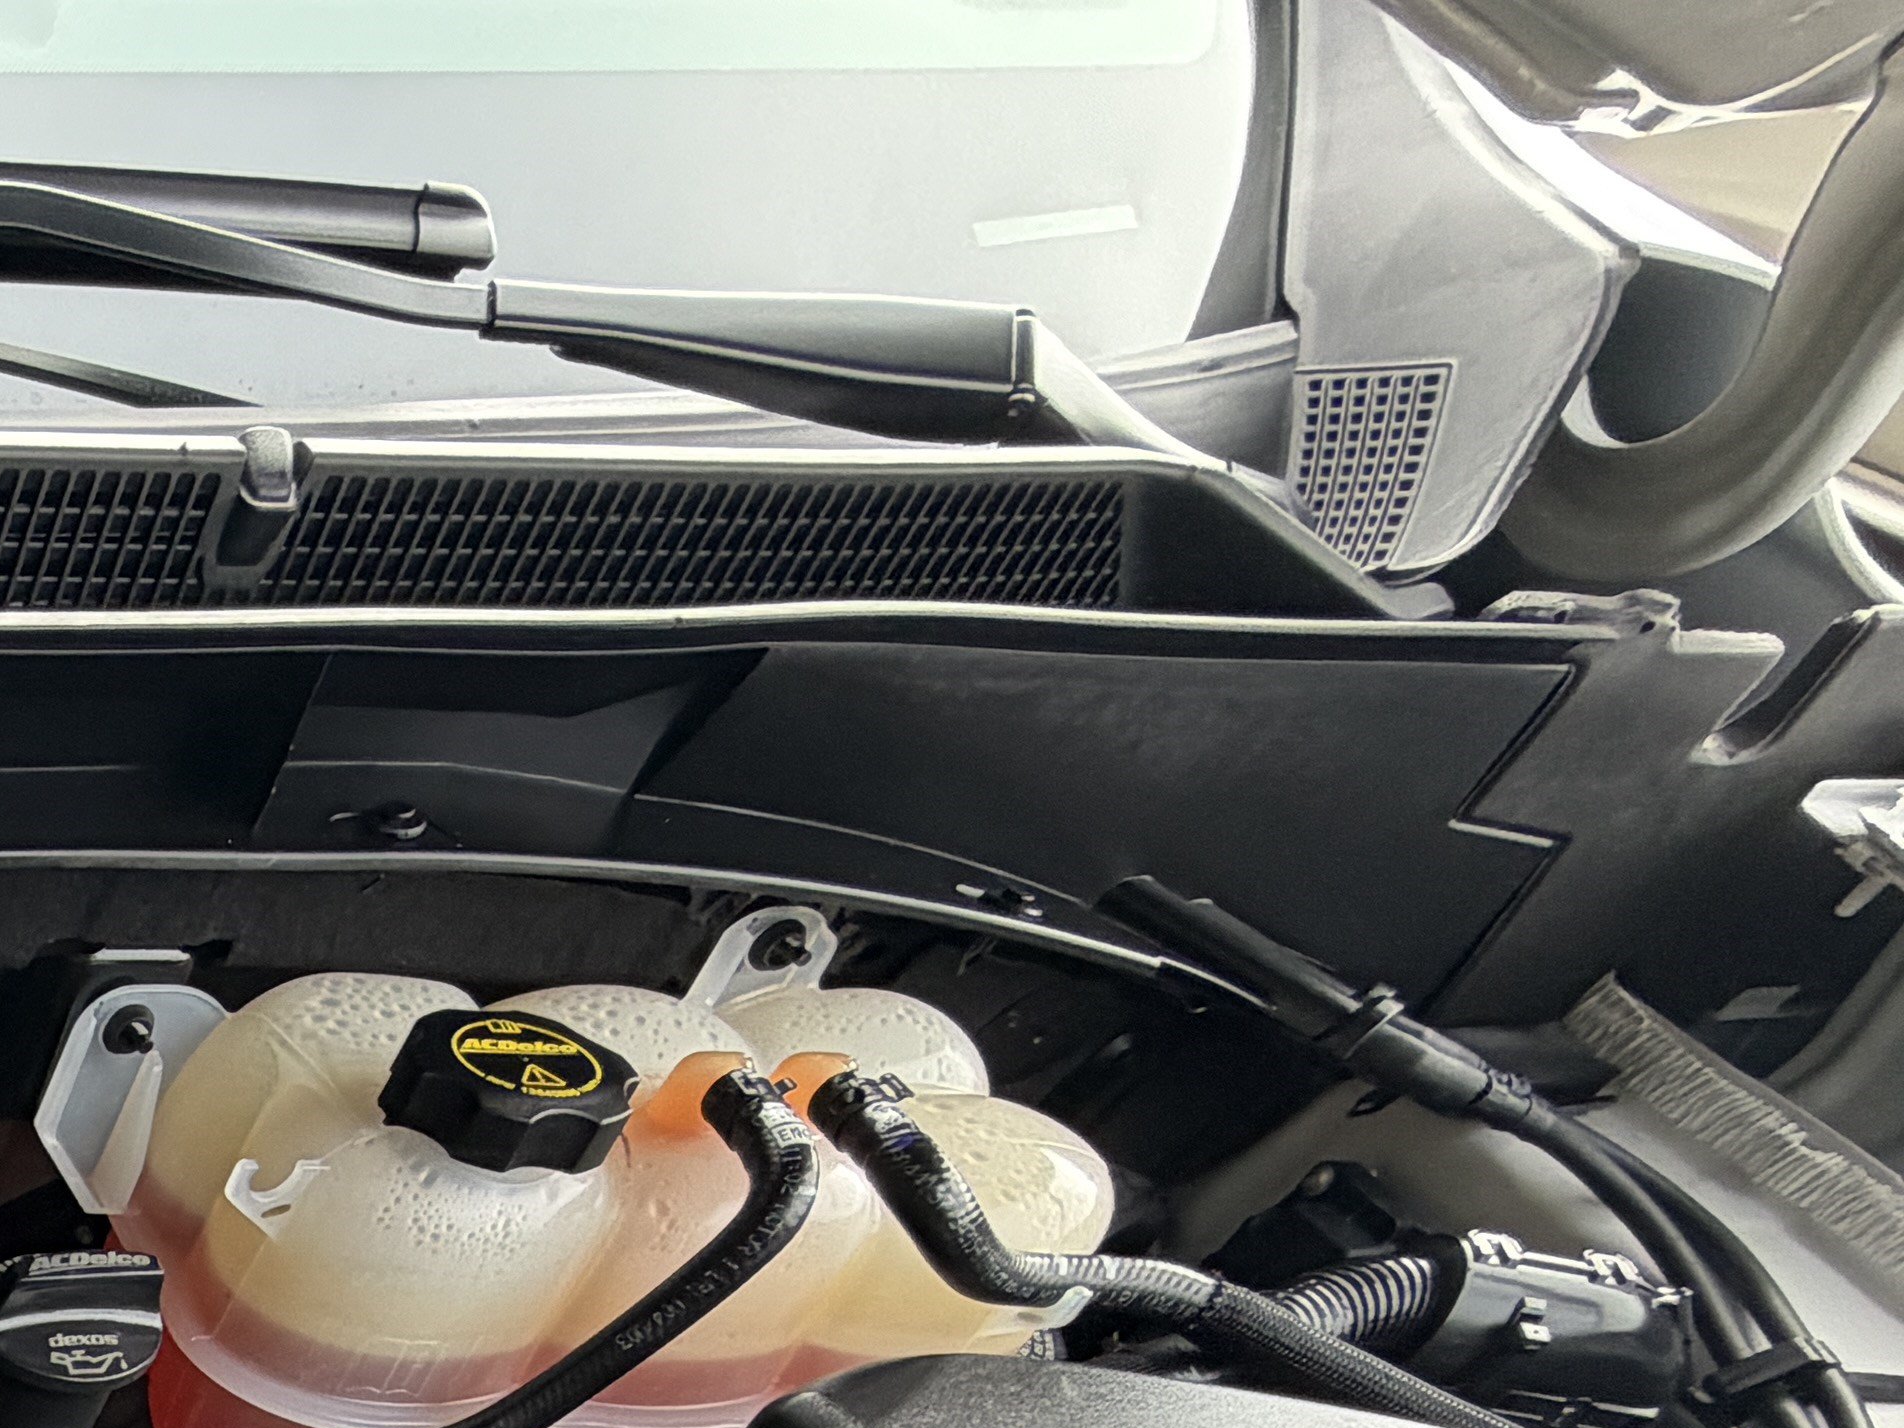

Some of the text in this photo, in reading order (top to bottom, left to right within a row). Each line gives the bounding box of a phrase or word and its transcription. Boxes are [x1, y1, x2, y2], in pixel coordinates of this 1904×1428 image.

[461, 1038, 580, 1055] ACDelco
[29, 1251, 151, 1271] ACDelco
[48, 1333, 119, 1348] dexos
